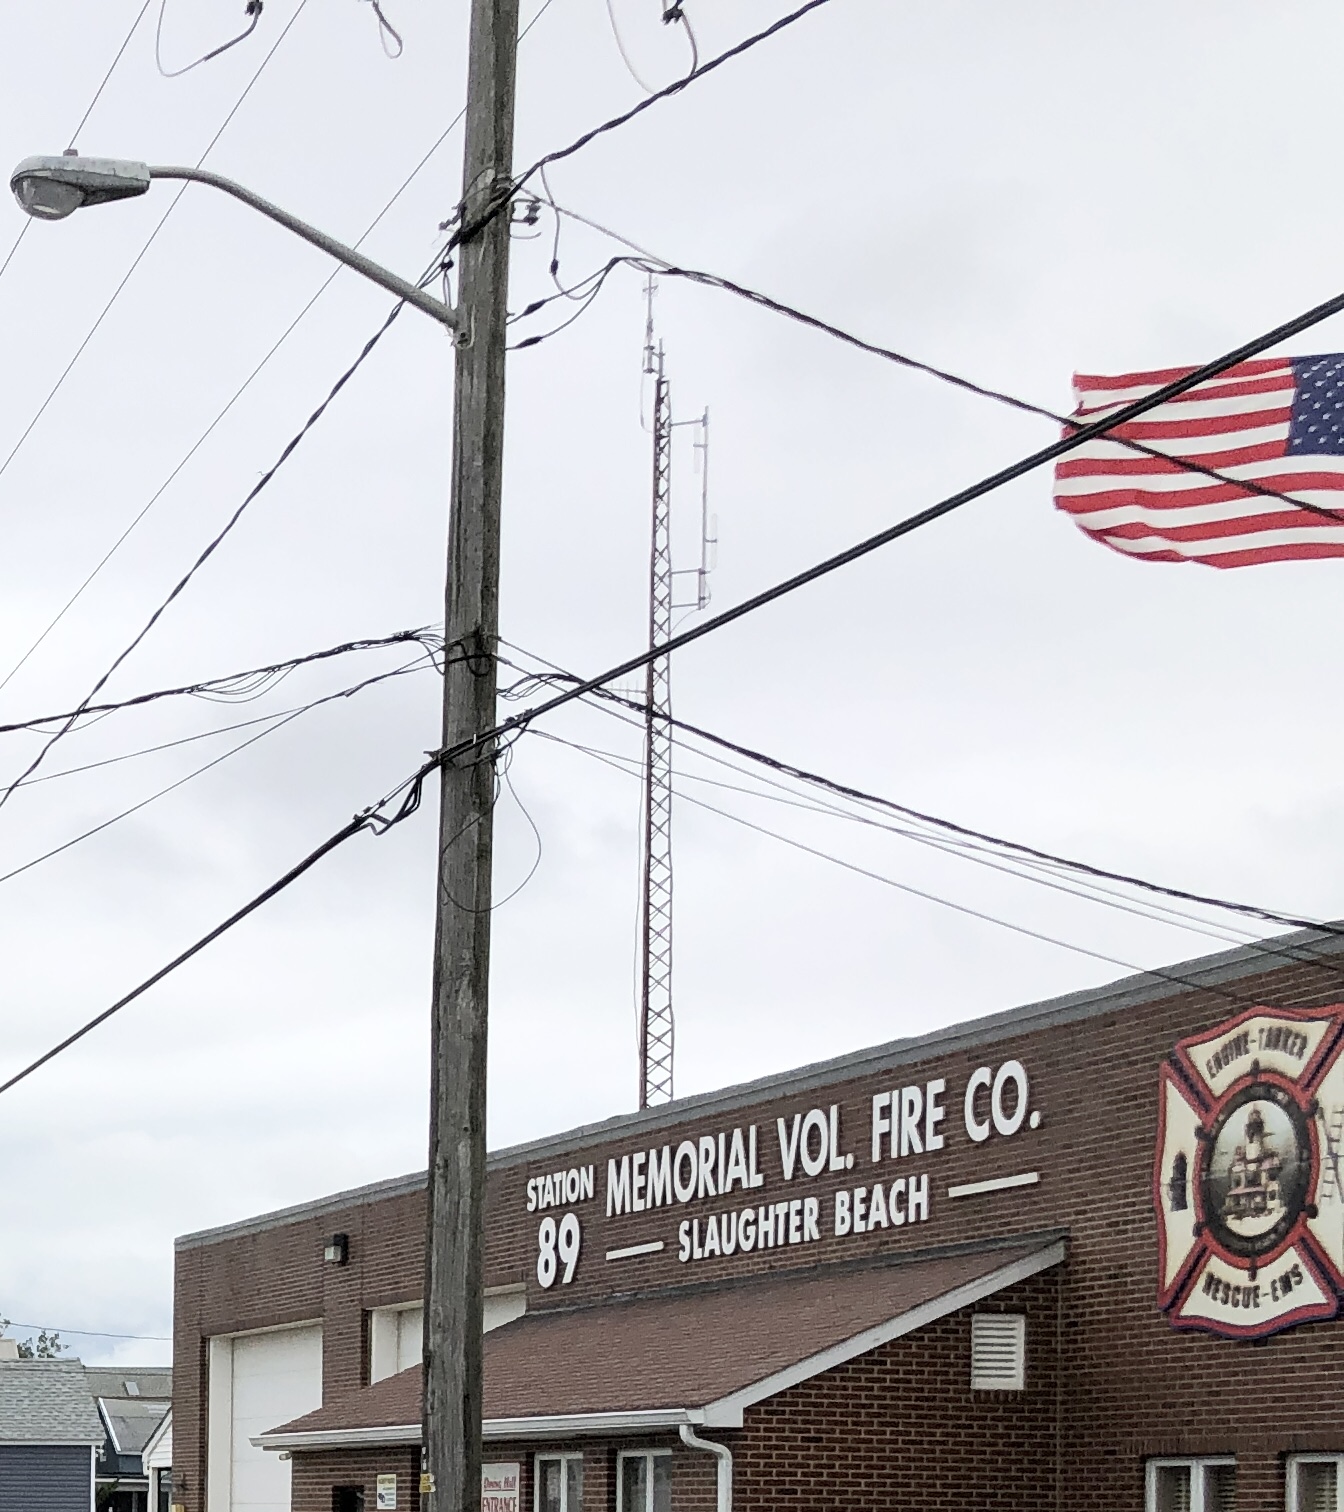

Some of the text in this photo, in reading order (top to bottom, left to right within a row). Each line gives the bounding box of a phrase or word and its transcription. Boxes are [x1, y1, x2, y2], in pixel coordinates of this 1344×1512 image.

[606, 1059, 1042, 1217] MEMORIAL VOL. FIRE CO.
[526, 1164, 594, 1212] STATION
[678, 1174, 929, 1262] SLAUGHTER BEACH
[537, 1212, 580, 1288] 89
